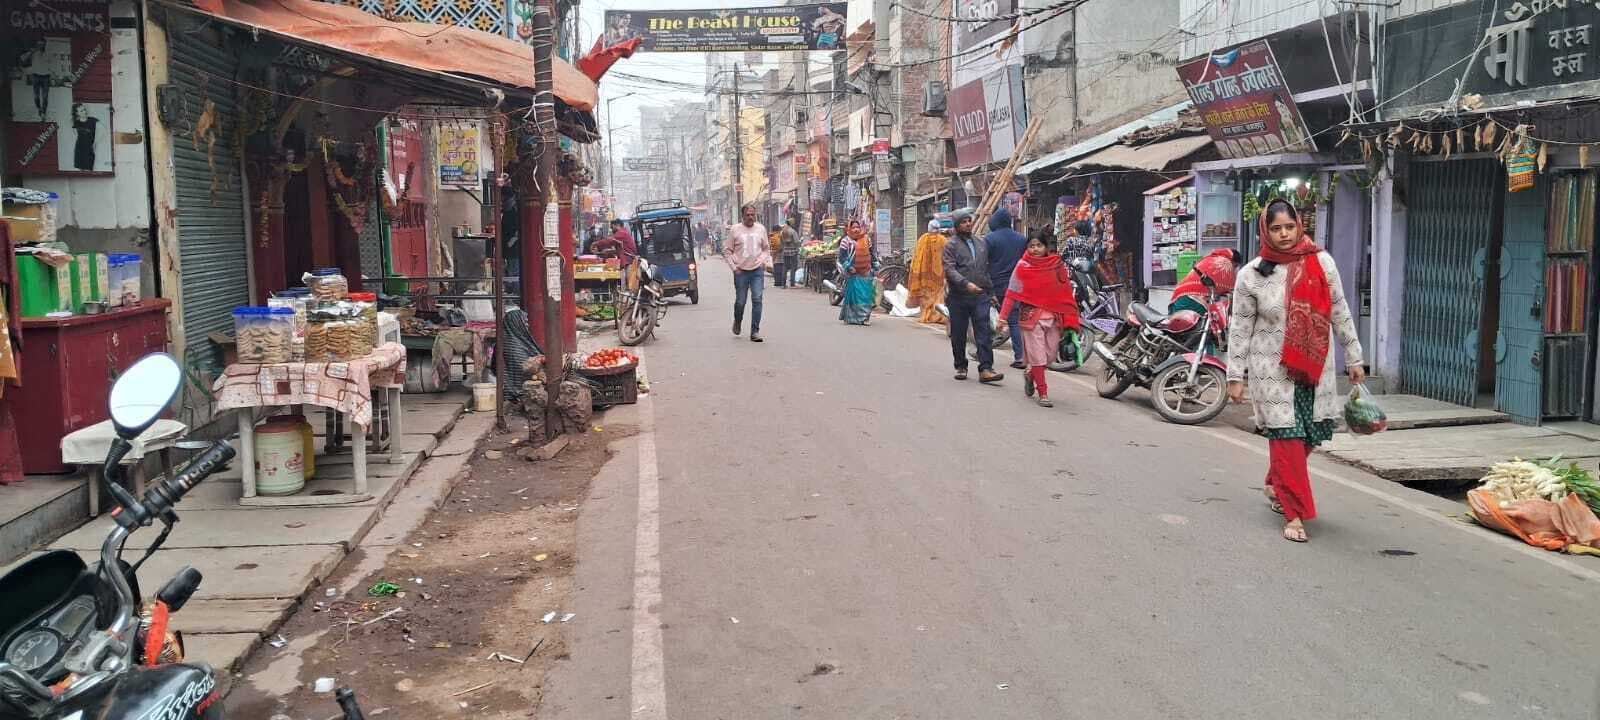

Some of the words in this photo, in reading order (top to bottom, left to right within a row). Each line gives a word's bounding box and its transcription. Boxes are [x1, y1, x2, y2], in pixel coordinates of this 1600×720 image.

[9, 10, 105, 32] GARMENTS
[647, 16, 683, 30] The
[687, 15, 738, 30] Beast
[743, 15, 801, 28] House
[1548, 24, 1592, 48] वस्त्र
[1211, 71, 1241, 99] गोल्ड
[1239, 55, 1281, 92] ज्वेलर्स
